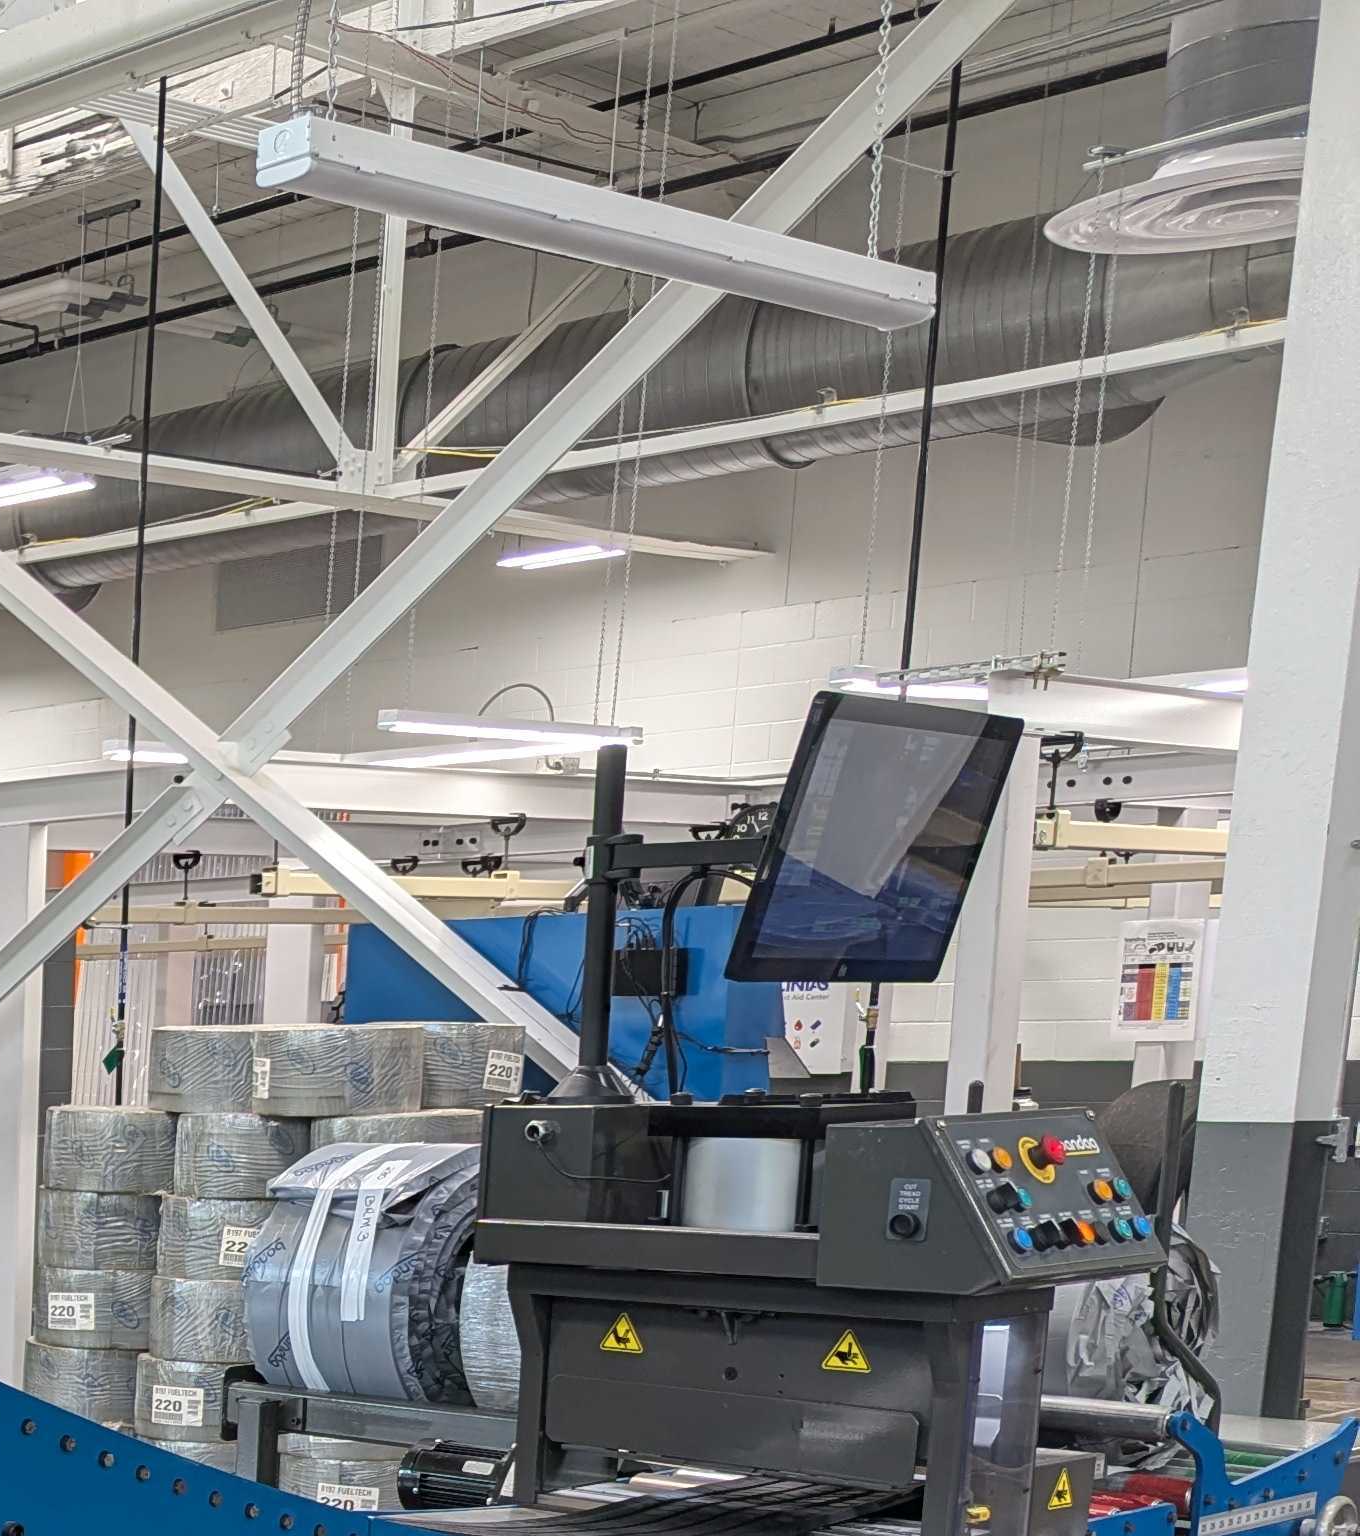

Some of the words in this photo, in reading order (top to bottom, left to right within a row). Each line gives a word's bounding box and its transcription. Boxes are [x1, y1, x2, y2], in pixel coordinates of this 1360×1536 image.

[758, 811, 769, 821] 12
[735, 823, 748, 833] 10
[488, 1063, 513, 1079] 220
[1061, 1134, 1101, 1154] andag
[49, 1305, 75, 1318] 220
[167, 1388, 198, 1398] FUELTECH
[154, 1398, 182, 1412] 220
[337, 1486, 372, 1497] FUELTECH
